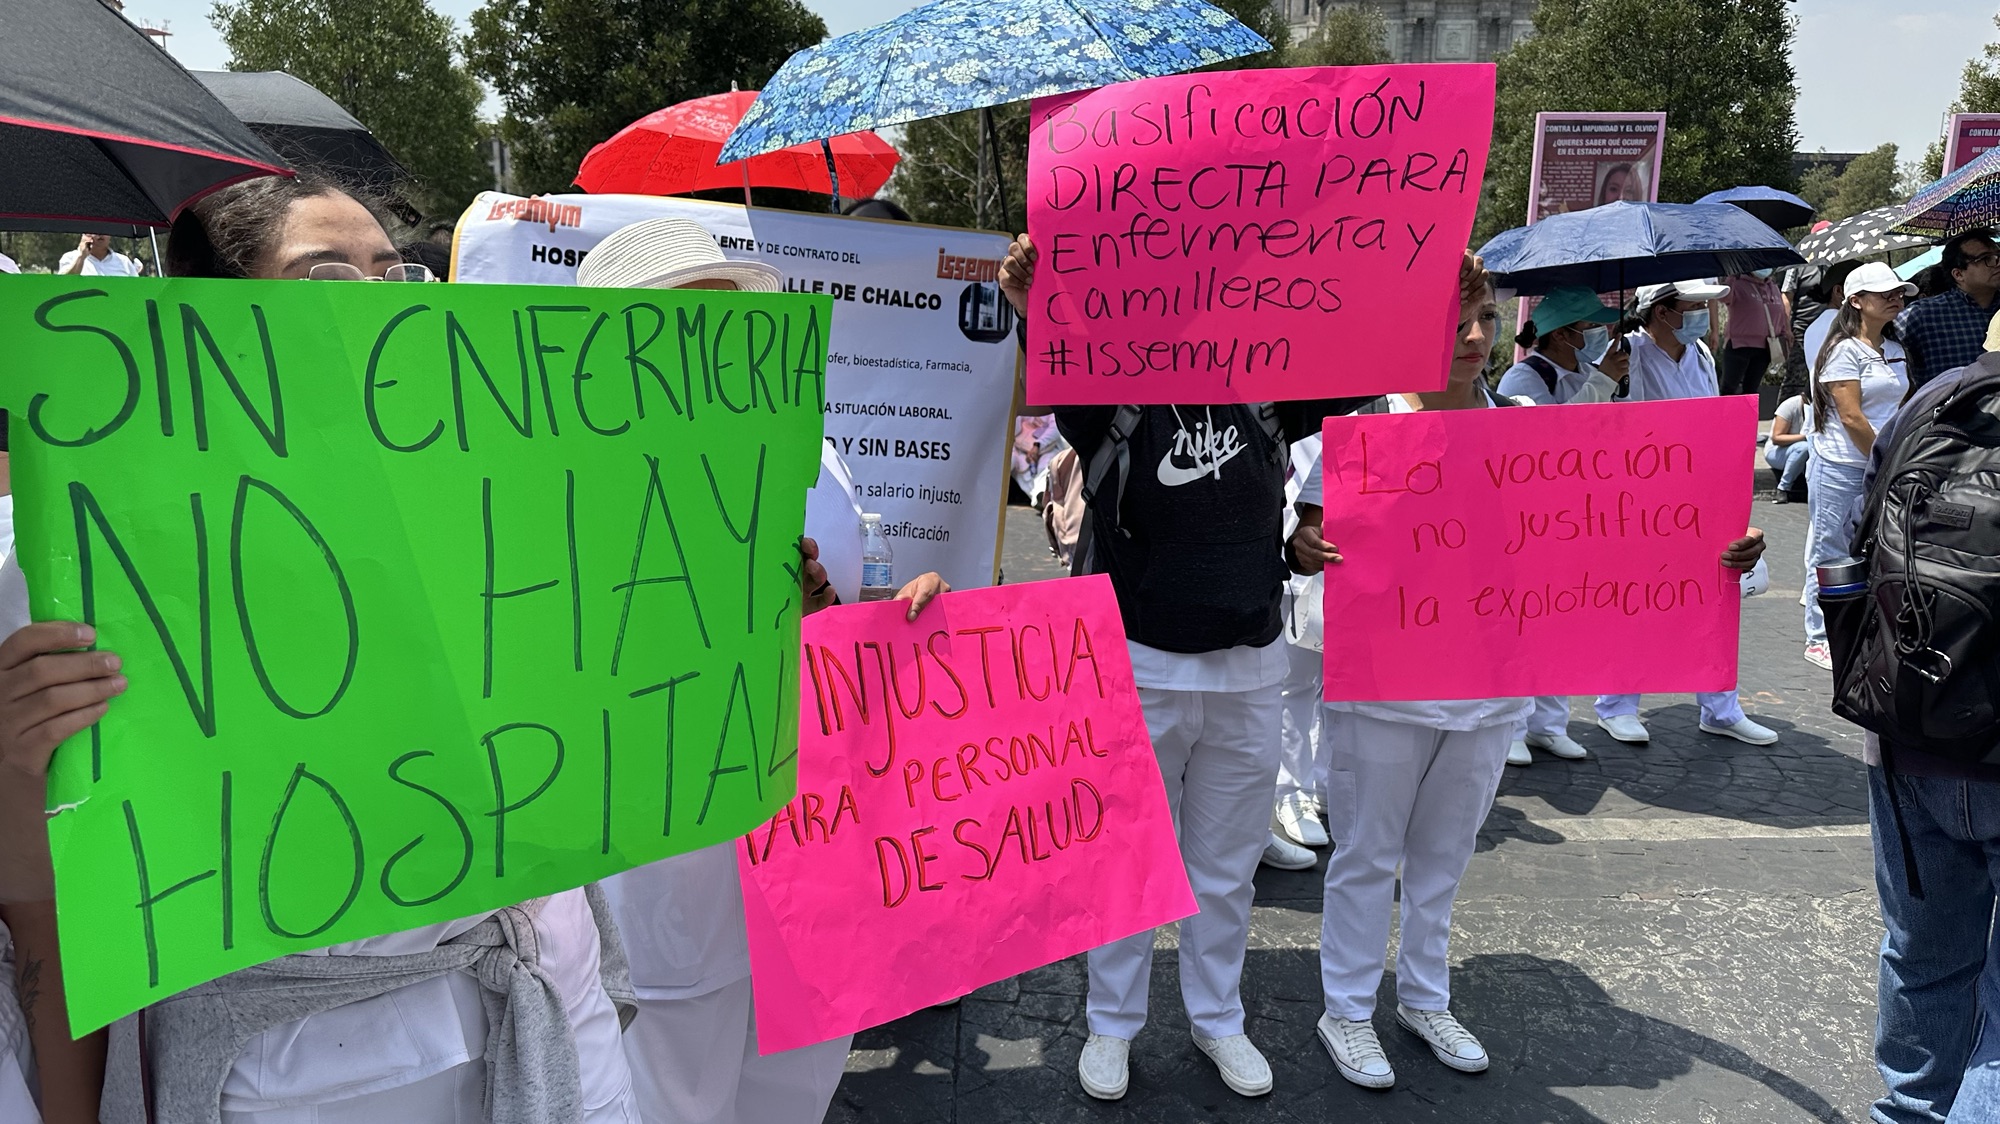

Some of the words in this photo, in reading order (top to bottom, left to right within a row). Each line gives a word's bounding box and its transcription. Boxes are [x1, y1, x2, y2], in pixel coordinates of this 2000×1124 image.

[1545, 125, 1571, 133] CONTRA
[1572, 125, 1581, 133] LA
[1582, 125, 1619, 133] IMPUNIDAD
[1620, 125, 1625, 133] Y
[1626, 125, 1633, 133] EL
[1634, 125, 1658, 133] OLVIDO
[1552, 138, 1584, 148] ¿QUIERES
[1584, 138, 1607, 146] SABER
[1608, 137, 1621, 147] QUÉ
[1622, 138, 1648, 146] OCURRE
[1557, 148, 1566, 156] EN
[1567, 148, 1575, 156] EL
[1576, 148, 1602, 156] ESTADO
[1603, 148, 1611, 156] DE
[1613, 147, 1641, 156] MÉXICO?
[1969, 128, 1993, 137] CONTRA
[1045, 159, 1291, 213] DIRECTA
[1313, 148, 1469, 199] PARA
[757, 242, 764, 252] Y
[766, 243, 780, 255] DE
[782, 245, 839, 262] CONTRATO
[842, 252, 860, 265] DEL
[831, 282, 856, 300] DE
[862, 287, 942, 310] CHALCO
[27, 287, 289, 458] SIN
[365, 302, 825, 453] ENFERMERIA
[853, 354, 923, 371] bioestadística,
[925, 359, 973, 374] Farmacia,
[835, 402, 896, 417] SITUACIÓN
[899, 405, 953, 420] LABORAL.
[842, 437, 854, 455] Y
[858, 438, 888, 457] SIN
[894, 439, 951, 461] BASES
[1358, 432, 1443, 495] La
[1484, 431, 1693, 489] vocación
[867, 482, 914, 499] salario
[919, 484, 963, 505] injusto.
[1413, 518, 1466, 554] no
[1504, 491, 1702, 555] justifica
[69, 475, 360, 783] NO
[478, 445, 768, 700] HAY
[1398, 585, 1440, 630] la
[804, 614, 1106, 778] INJUSTICIA
[903, 716, 1109, 808] PERSONAL
[124, 650, 800, 989] HOSPITAL
[874, 825, 947, 909] DE
